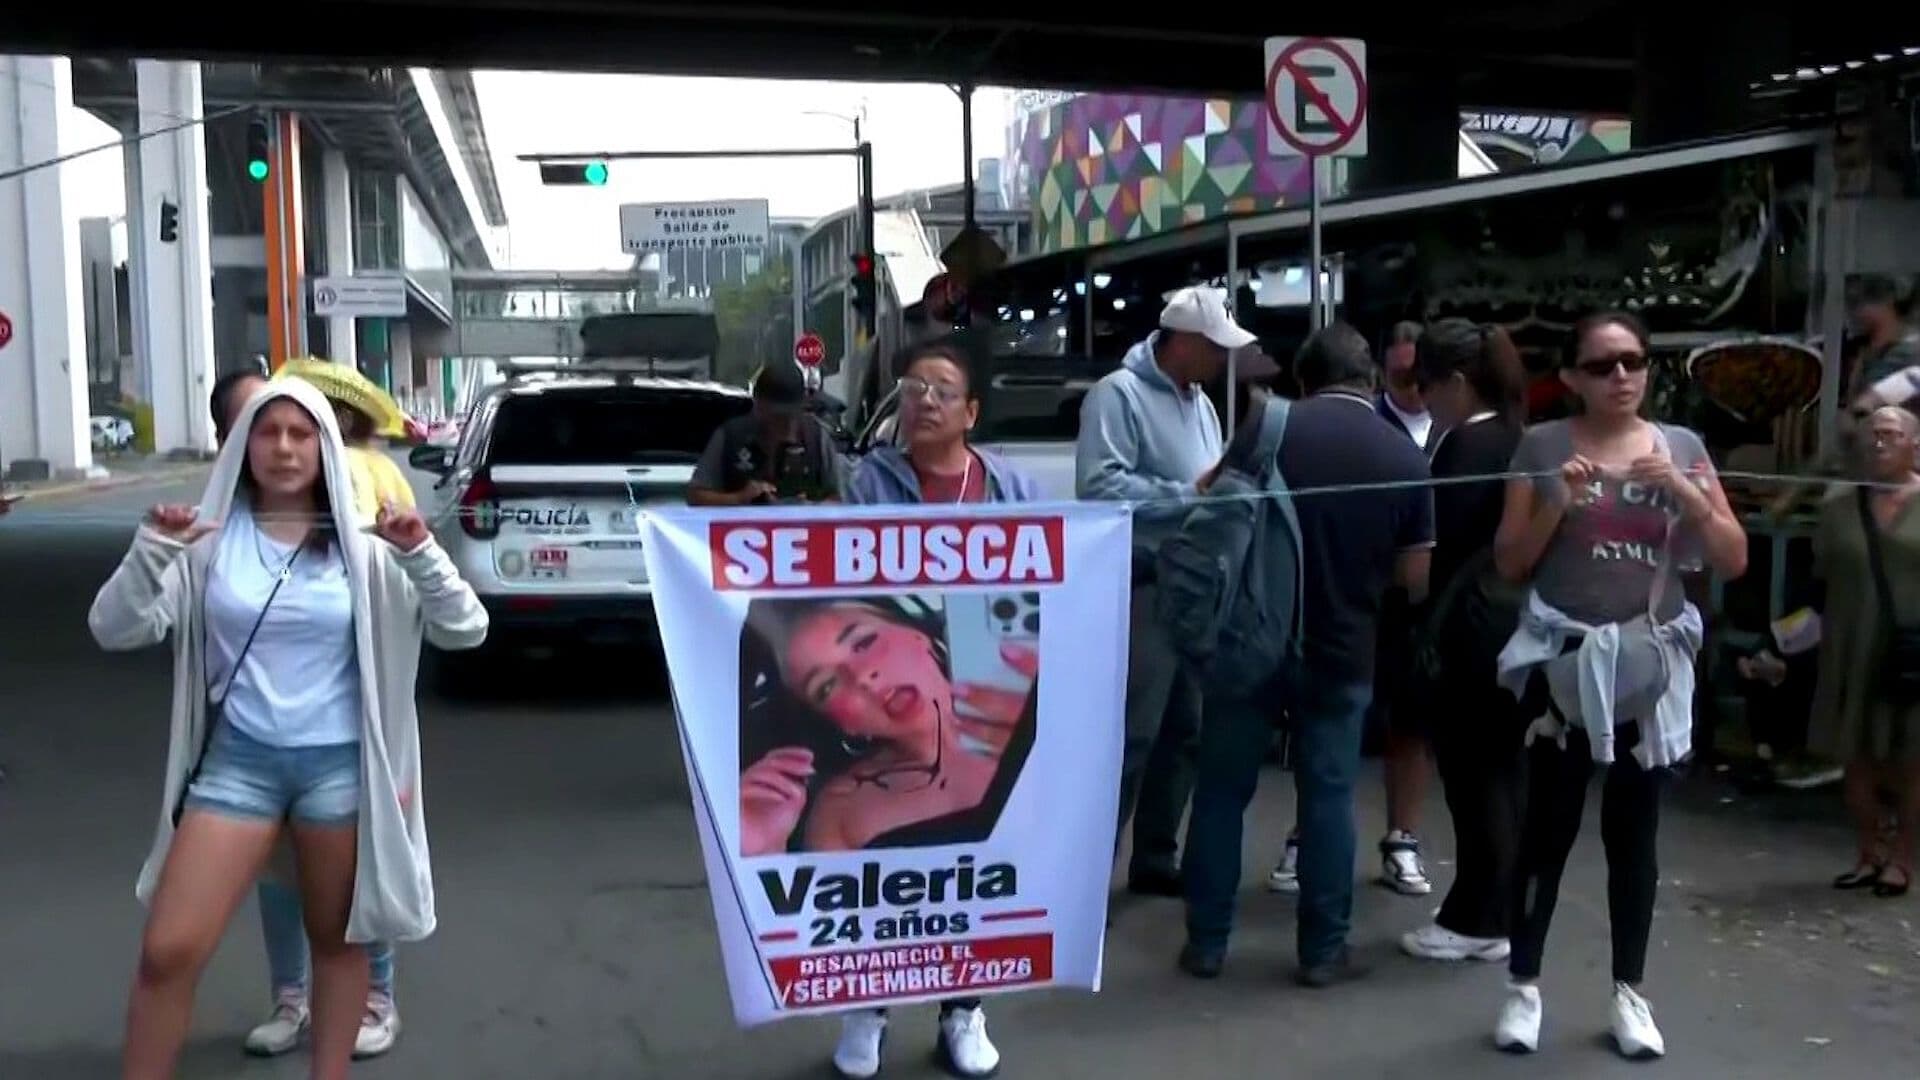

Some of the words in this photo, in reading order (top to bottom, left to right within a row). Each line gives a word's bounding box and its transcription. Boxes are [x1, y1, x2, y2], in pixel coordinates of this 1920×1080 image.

[663, 221, 708, 233] Salida
[712, 220, 730, 231] de
[499, 503, 590, 525] POLICÍA
[724, 527, 811, 587] SE
[834, 524, 1054, 583] BUSCA
[757, 855, 1018, 917] Valeria
[810, 914, 862, 946] 24
[873, 908, 970, 941] años
[951, 945, 975, 960] EL
